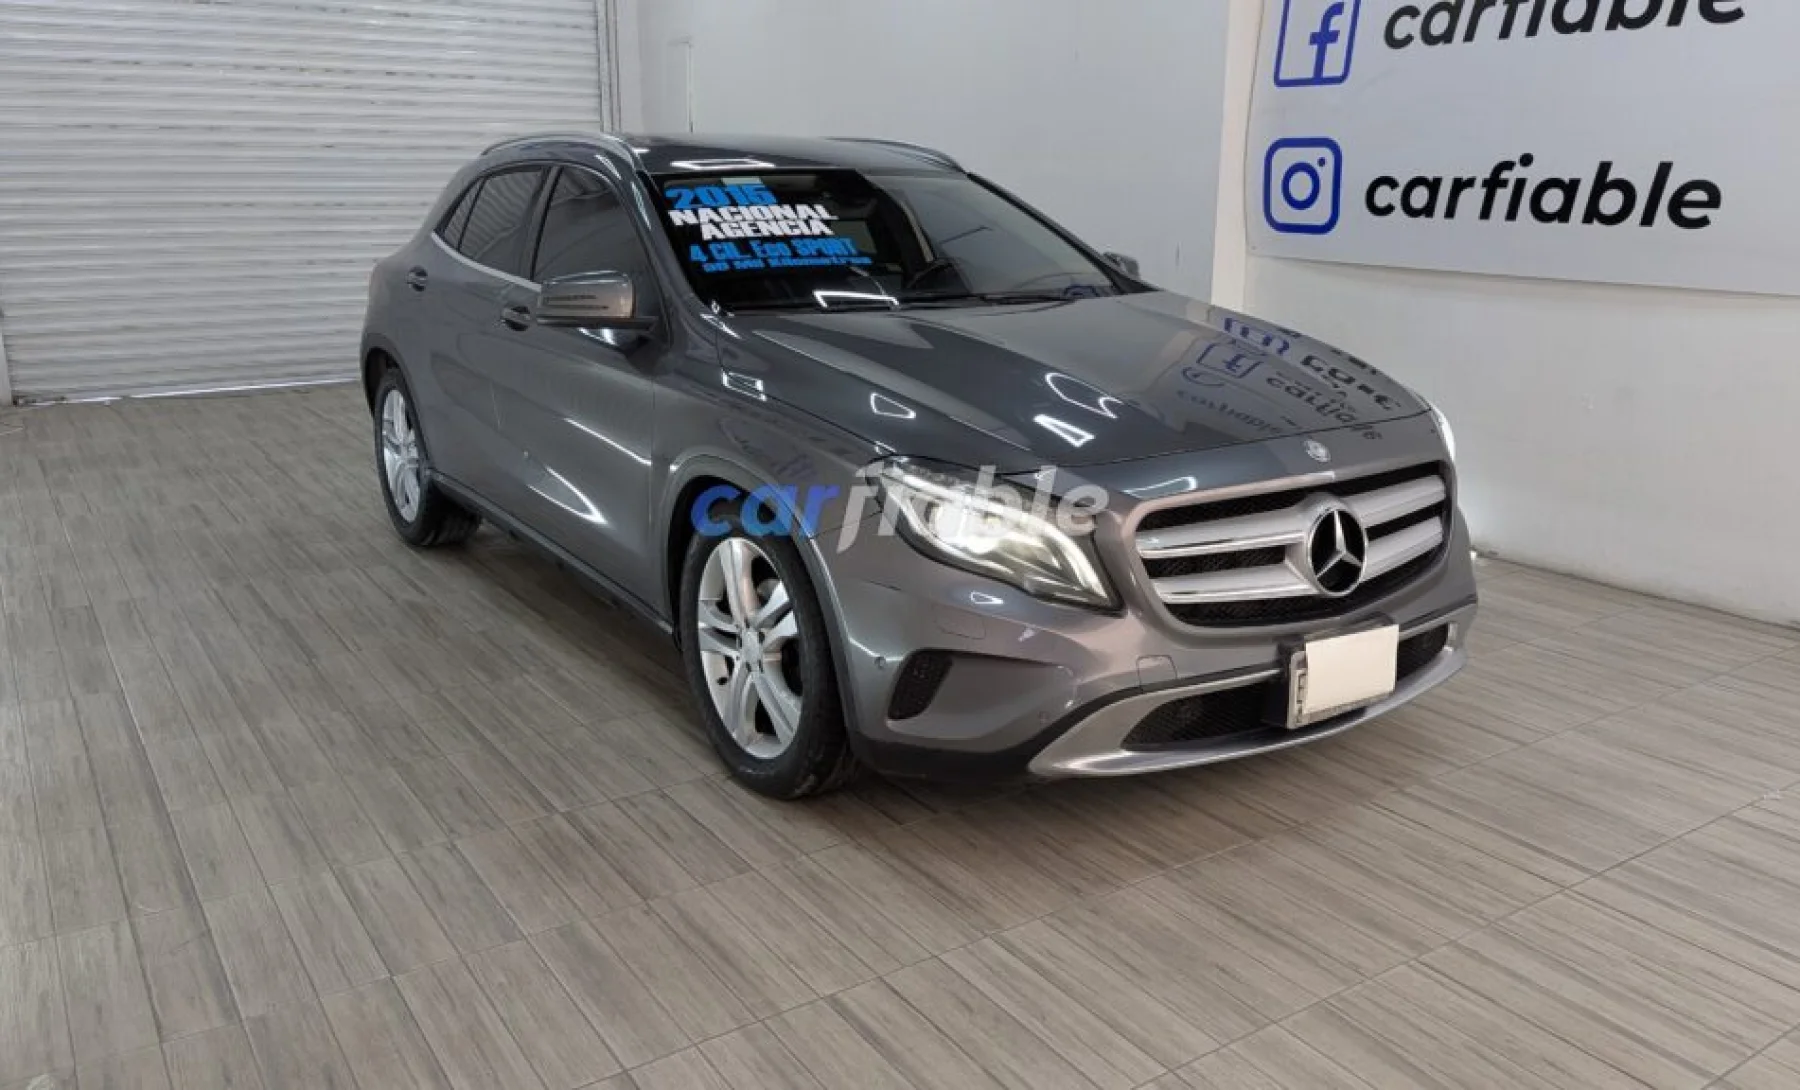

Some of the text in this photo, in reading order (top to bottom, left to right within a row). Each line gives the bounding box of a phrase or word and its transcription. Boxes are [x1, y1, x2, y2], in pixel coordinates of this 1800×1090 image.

[1365, 153, 1722, 229] carfiable
[668, 204, 838, 226] NACIONAL
[701, 220, 833, 240] AGENCIA
[790, 237, 858, 257] SPORT
